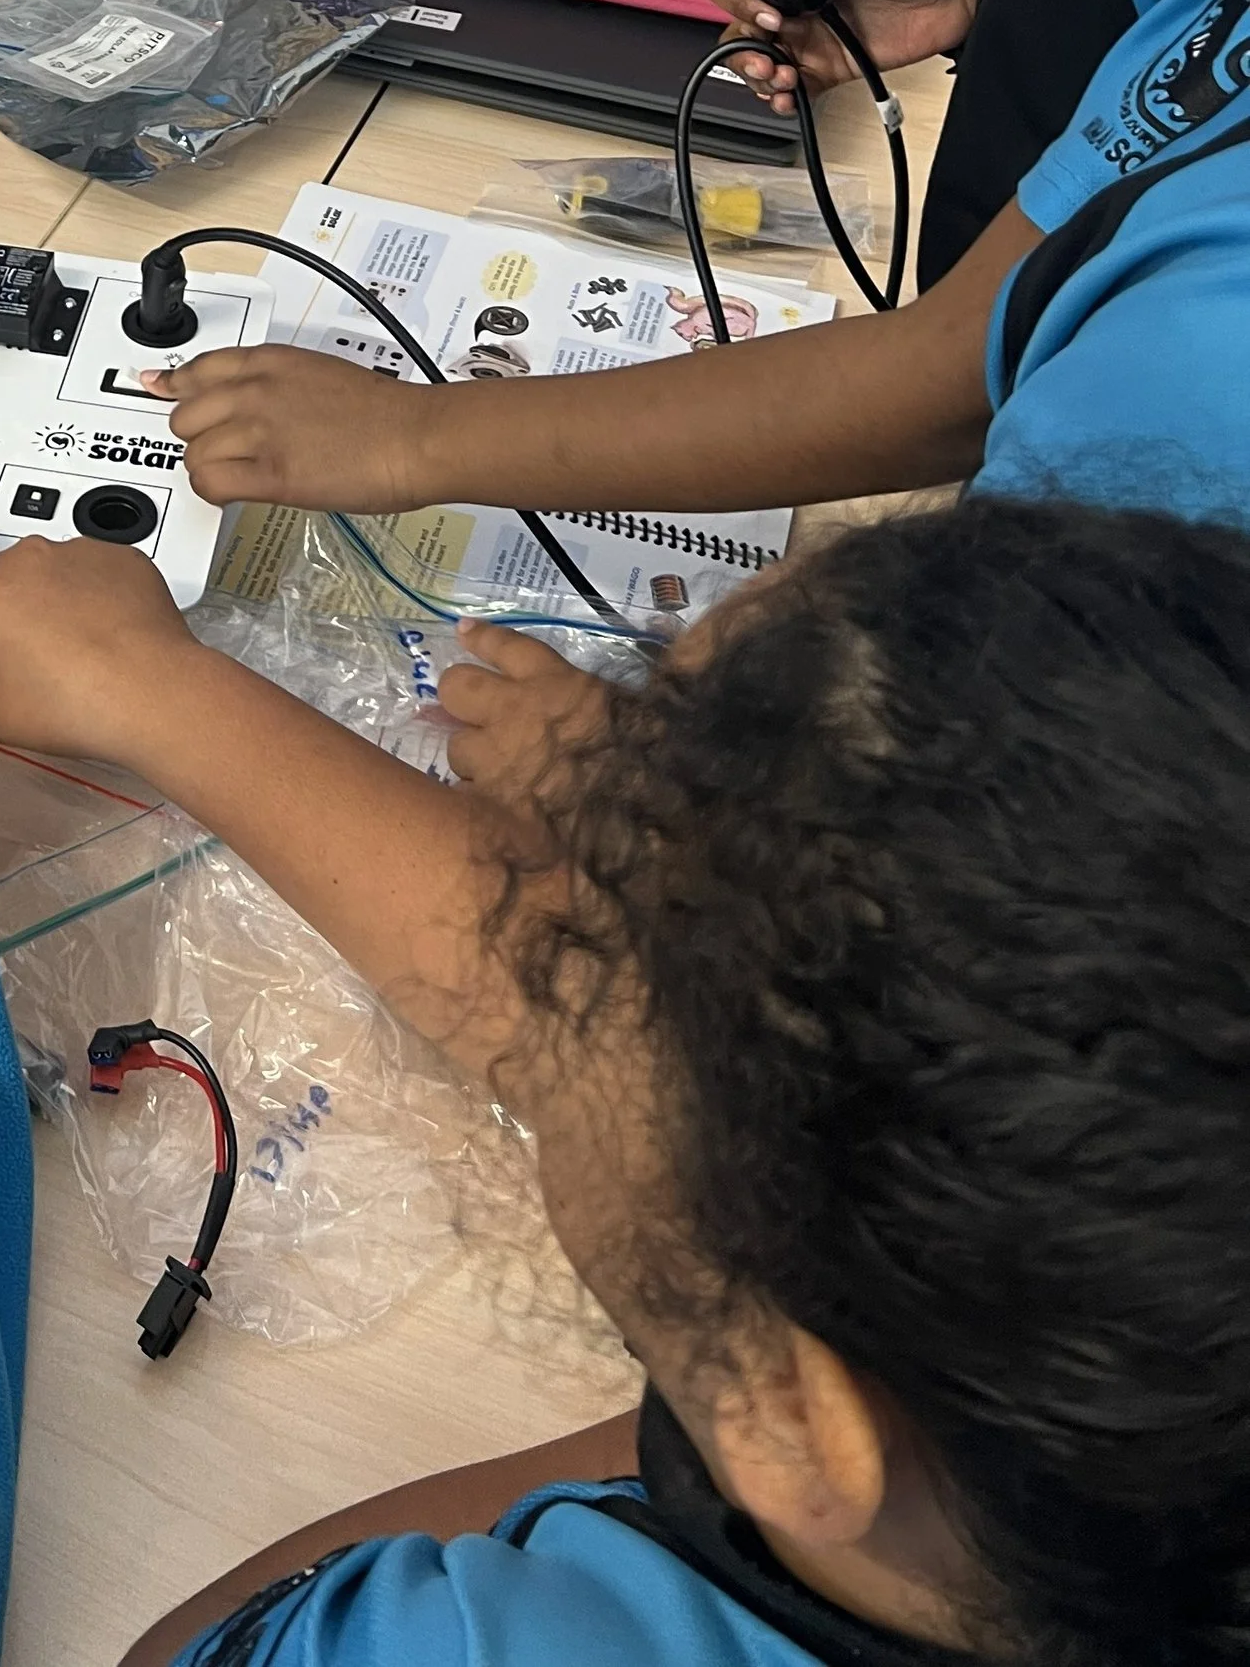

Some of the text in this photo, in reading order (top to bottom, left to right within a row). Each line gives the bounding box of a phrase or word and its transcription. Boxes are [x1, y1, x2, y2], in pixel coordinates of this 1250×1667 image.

[124, 31, 166, 64] PITSCO
[504, 266, 513, 278] about
[93, 431, 185, 453] we share
